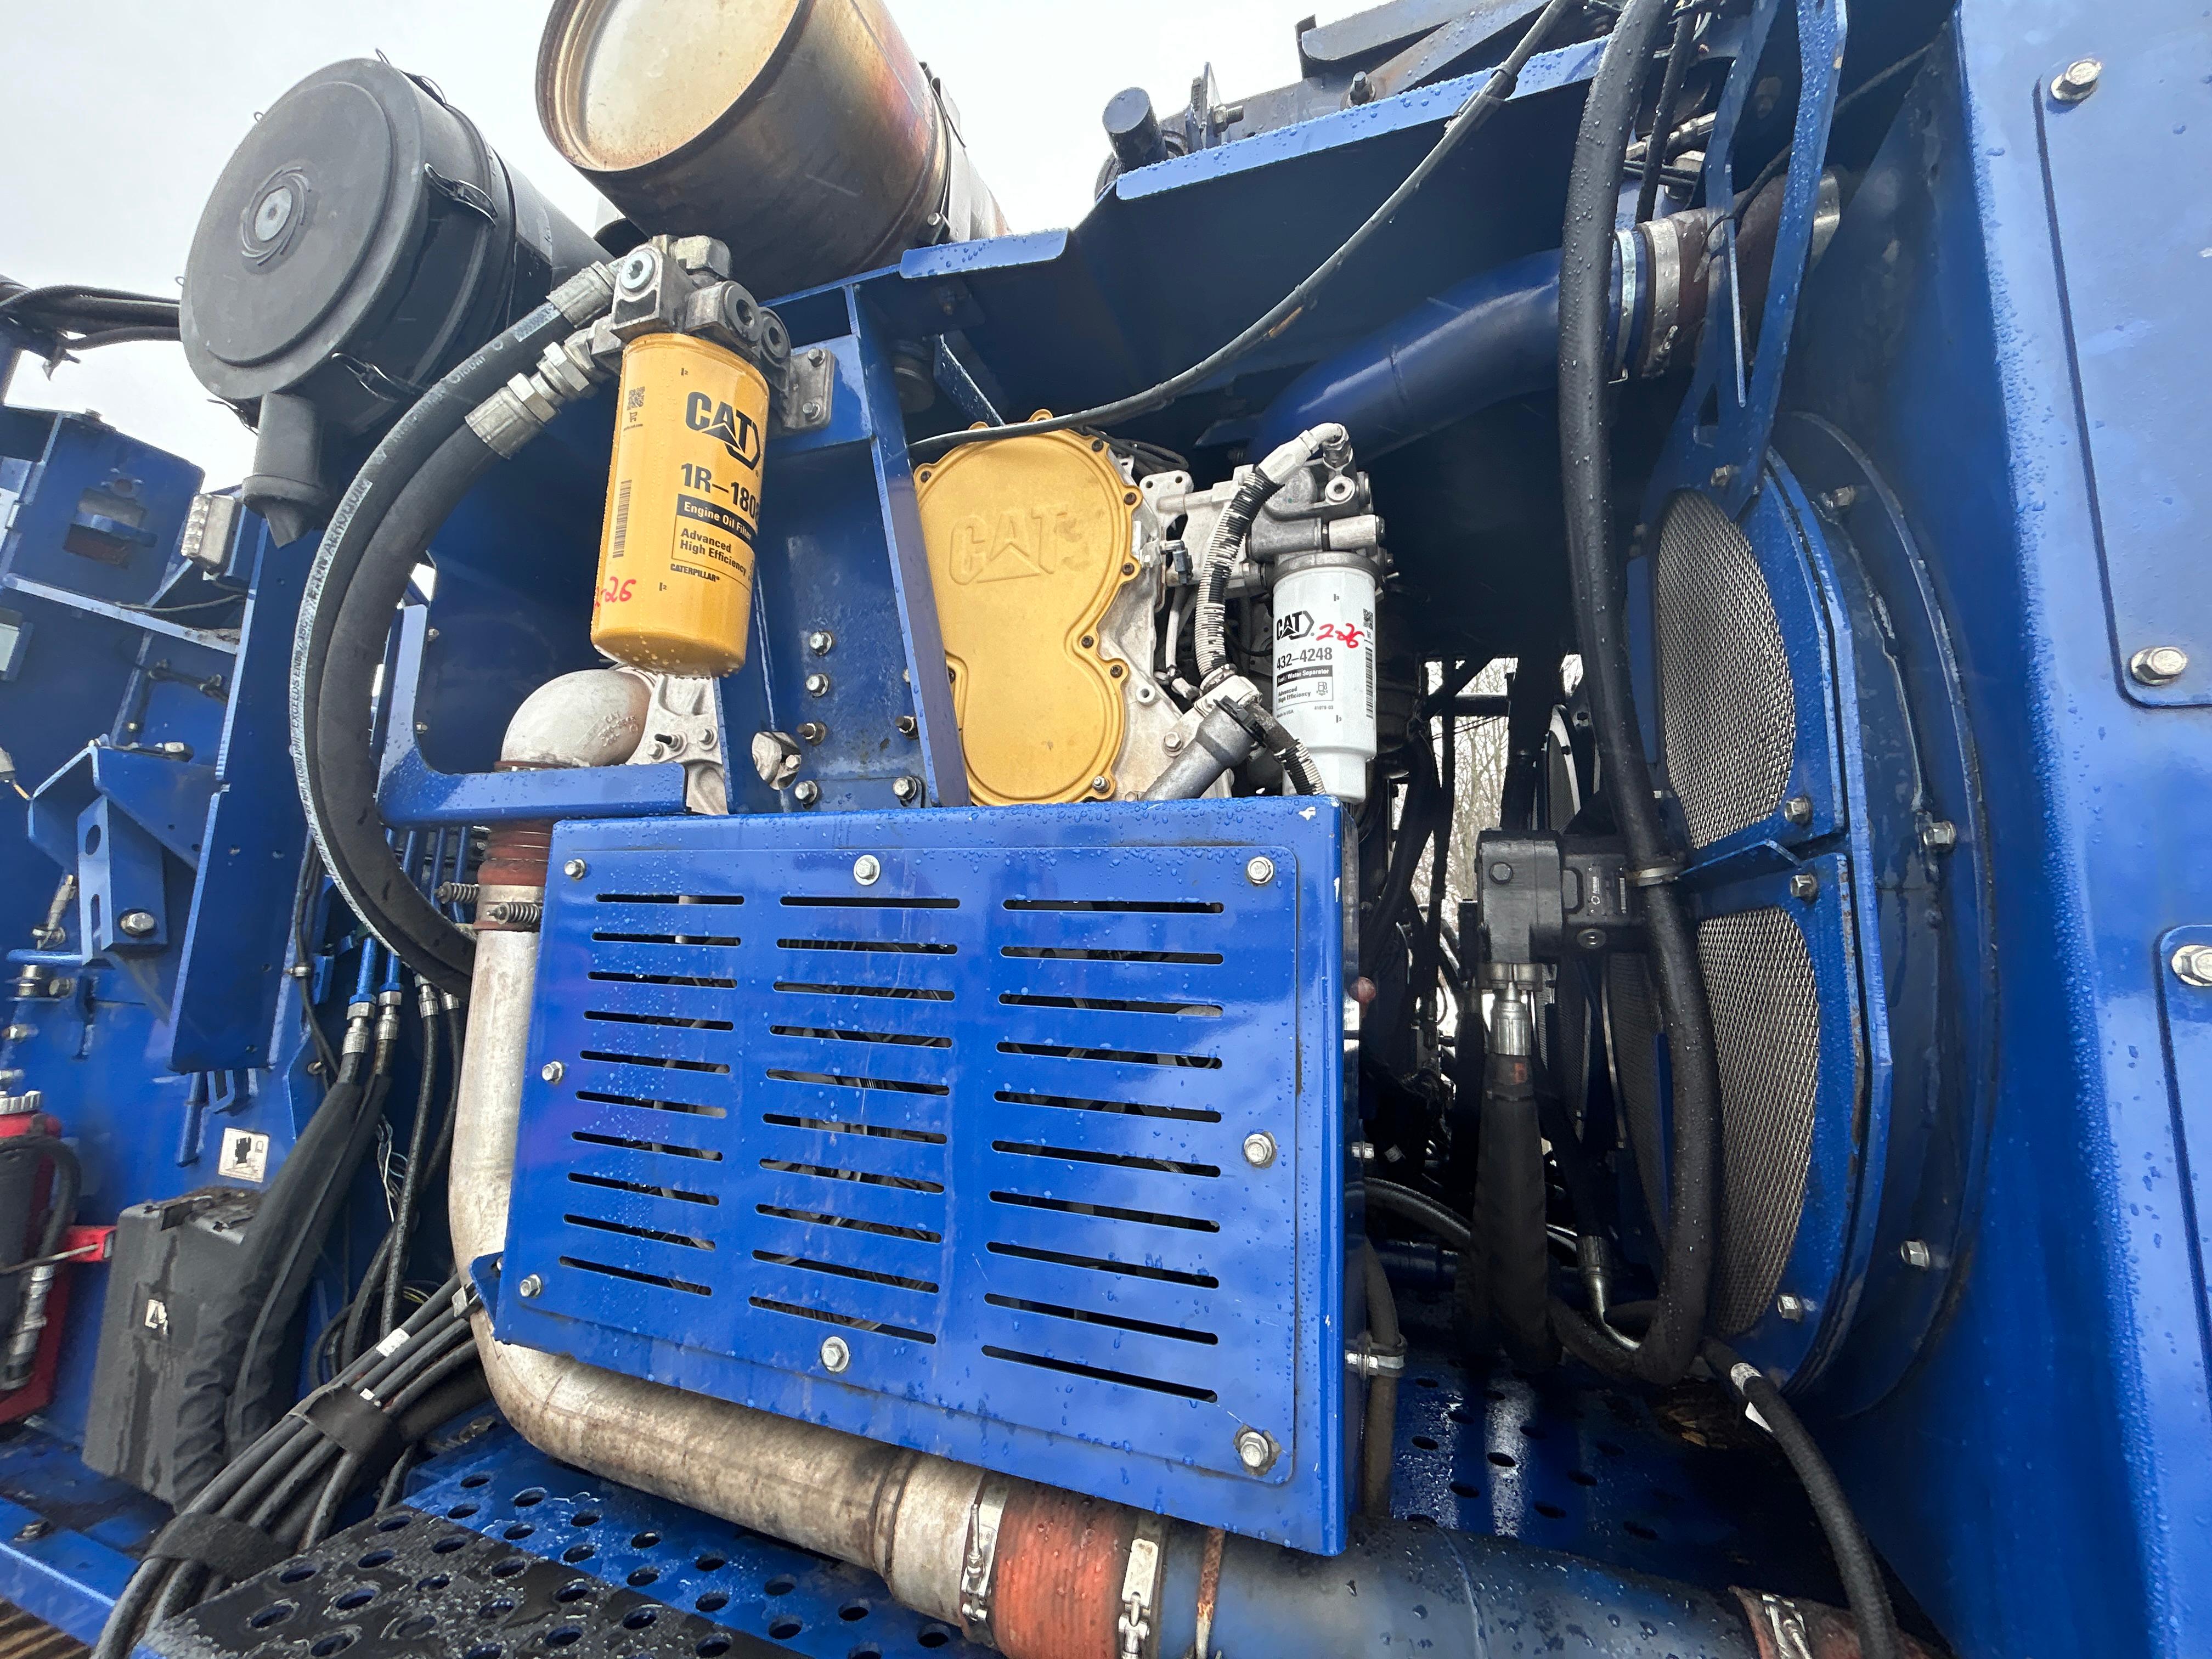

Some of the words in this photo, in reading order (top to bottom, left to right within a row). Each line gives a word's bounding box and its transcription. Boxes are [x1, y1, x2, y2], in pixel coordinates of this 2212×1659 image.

[686, 391, 757, 461] CAT
[684, 501, 720, 520] Engine
[723, 515, 735, 529] Oil
[736, 521, 752, 540] Filter
[680, 528, 731, 553] Advanced
[949, 504, 1069, 585] CAT
[680, 539, 706, 555] High
[708, 548, 747, 577] Efficiency
[1276, 610, 1311, 641] CAT
[1276, 647, 1333, 670] 432-4248
[291, 680, 300, 729] EXCEEDS
[1278, 686, 1297, 697] Advanced
[1286, 692, 1311, 701] Efficiency
